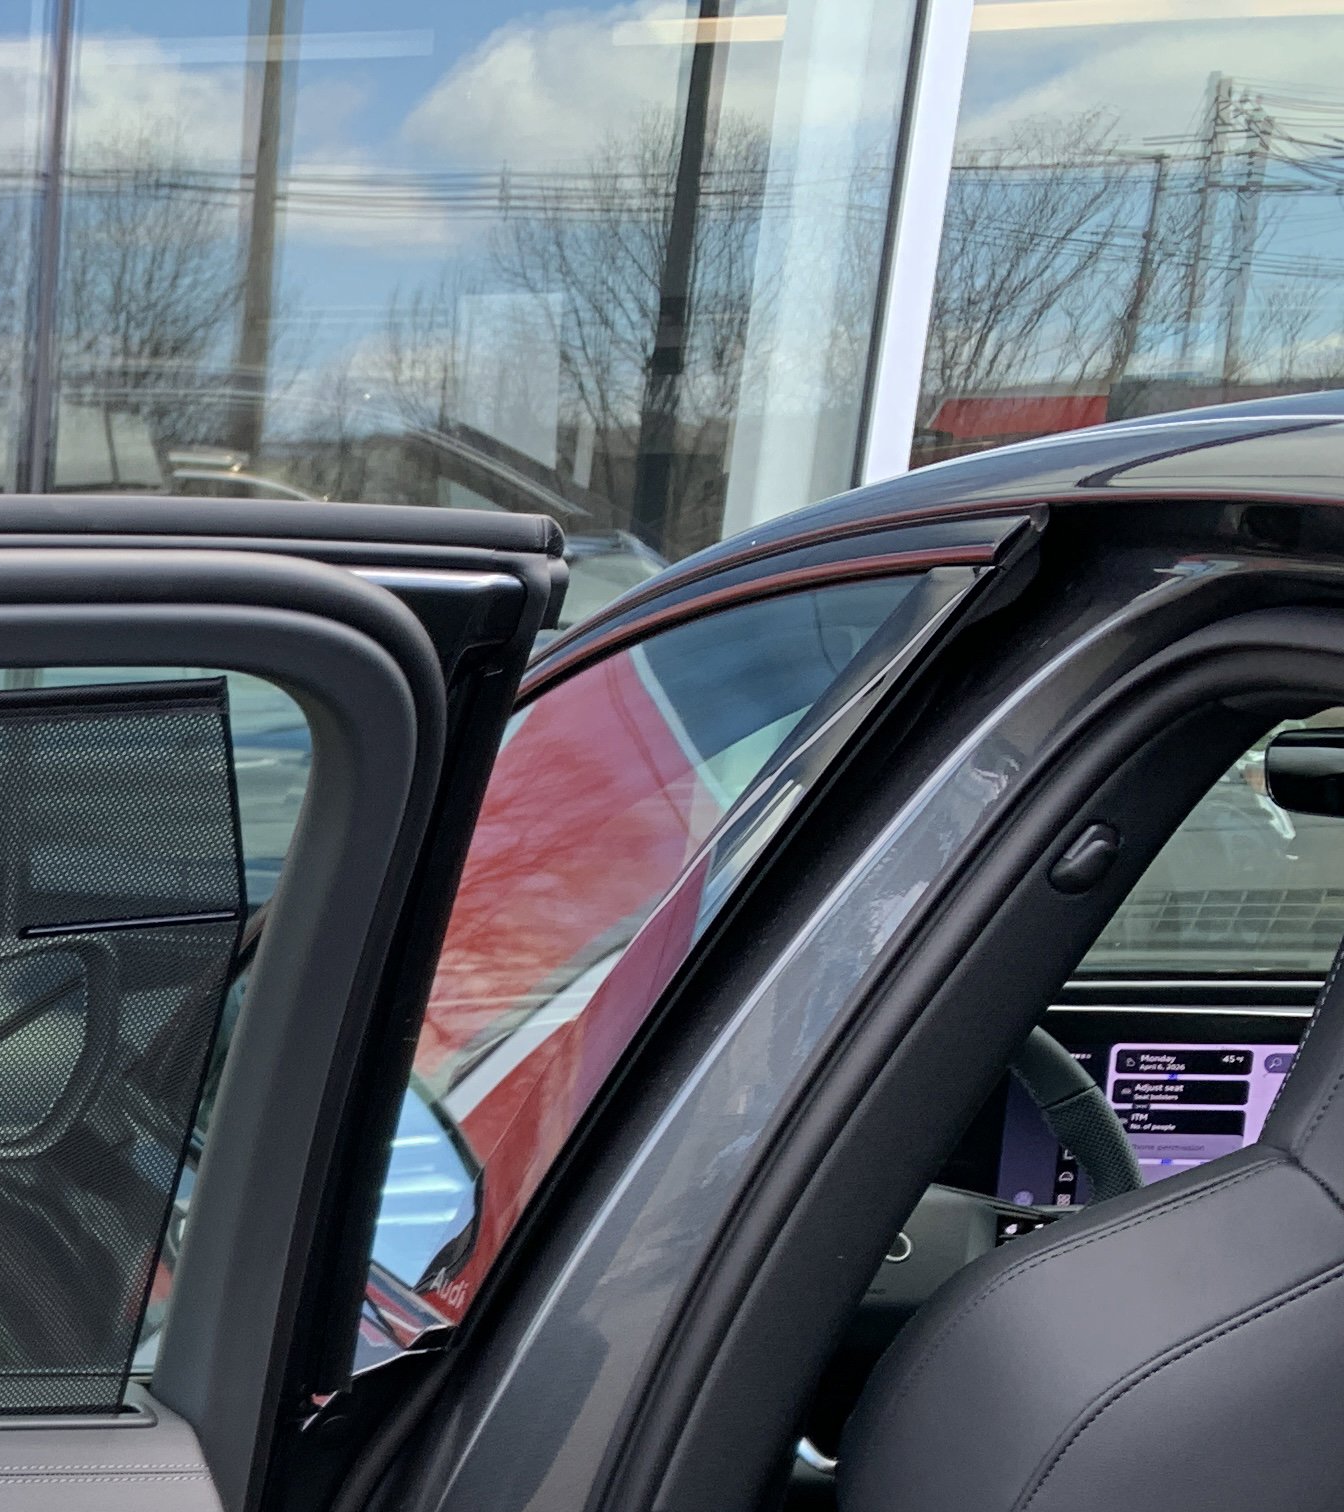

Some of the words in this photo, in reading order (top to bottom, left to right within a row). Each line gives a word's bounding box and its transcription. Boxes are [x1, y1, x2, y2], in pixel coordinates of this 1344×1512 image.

[1140, 1054, 1177, 1064] Monday
[1139, 1063, 1157, 1072] April
[1134, 1083, 1164, 1093] Adjust
[1164, 1084, 1184, 1092] seat
[1151, 1123, 1176, 1131] people
[429, 1266, 470, 1309] Audi
